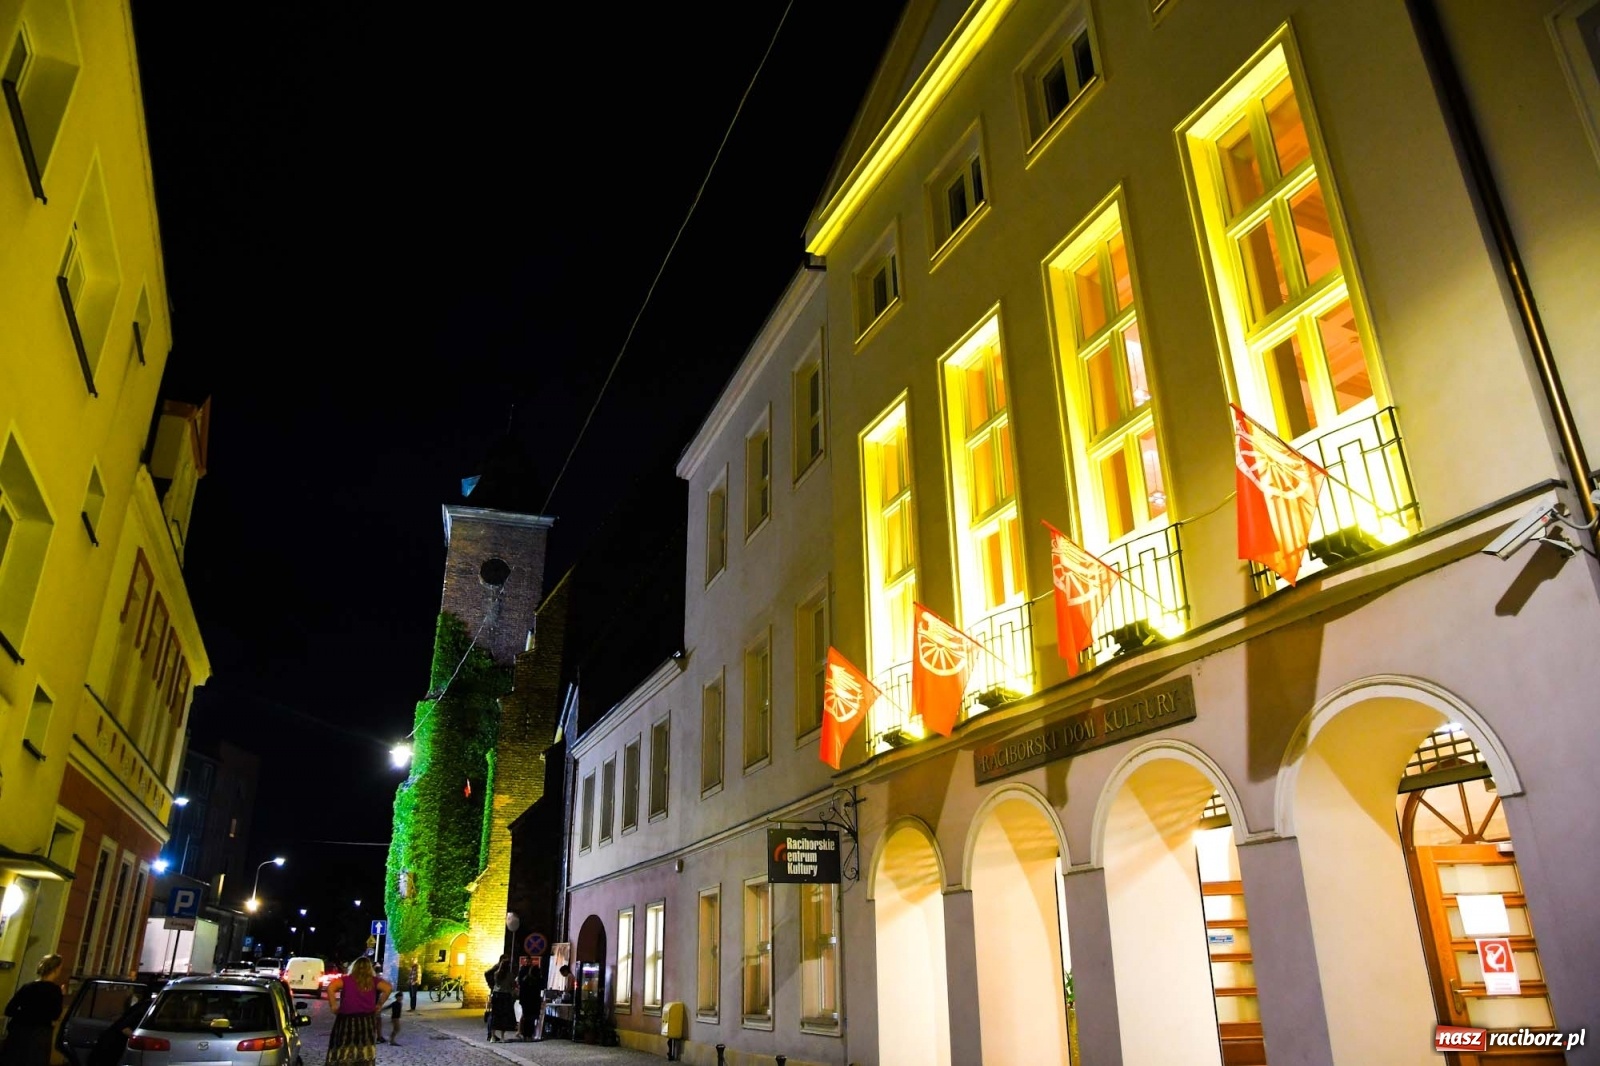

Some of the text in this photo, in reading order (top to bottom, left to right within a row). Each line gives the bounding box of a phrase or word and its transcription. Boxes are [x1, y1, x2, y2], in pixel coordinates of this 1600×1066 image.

[980, 691, 1178, 772] RACIBORSKI DOM KULTURY
[786, 837, 836, 851] Raciborskie
[787, 862, 818, 877] Kultury
[173, 890, 195, 913] P
